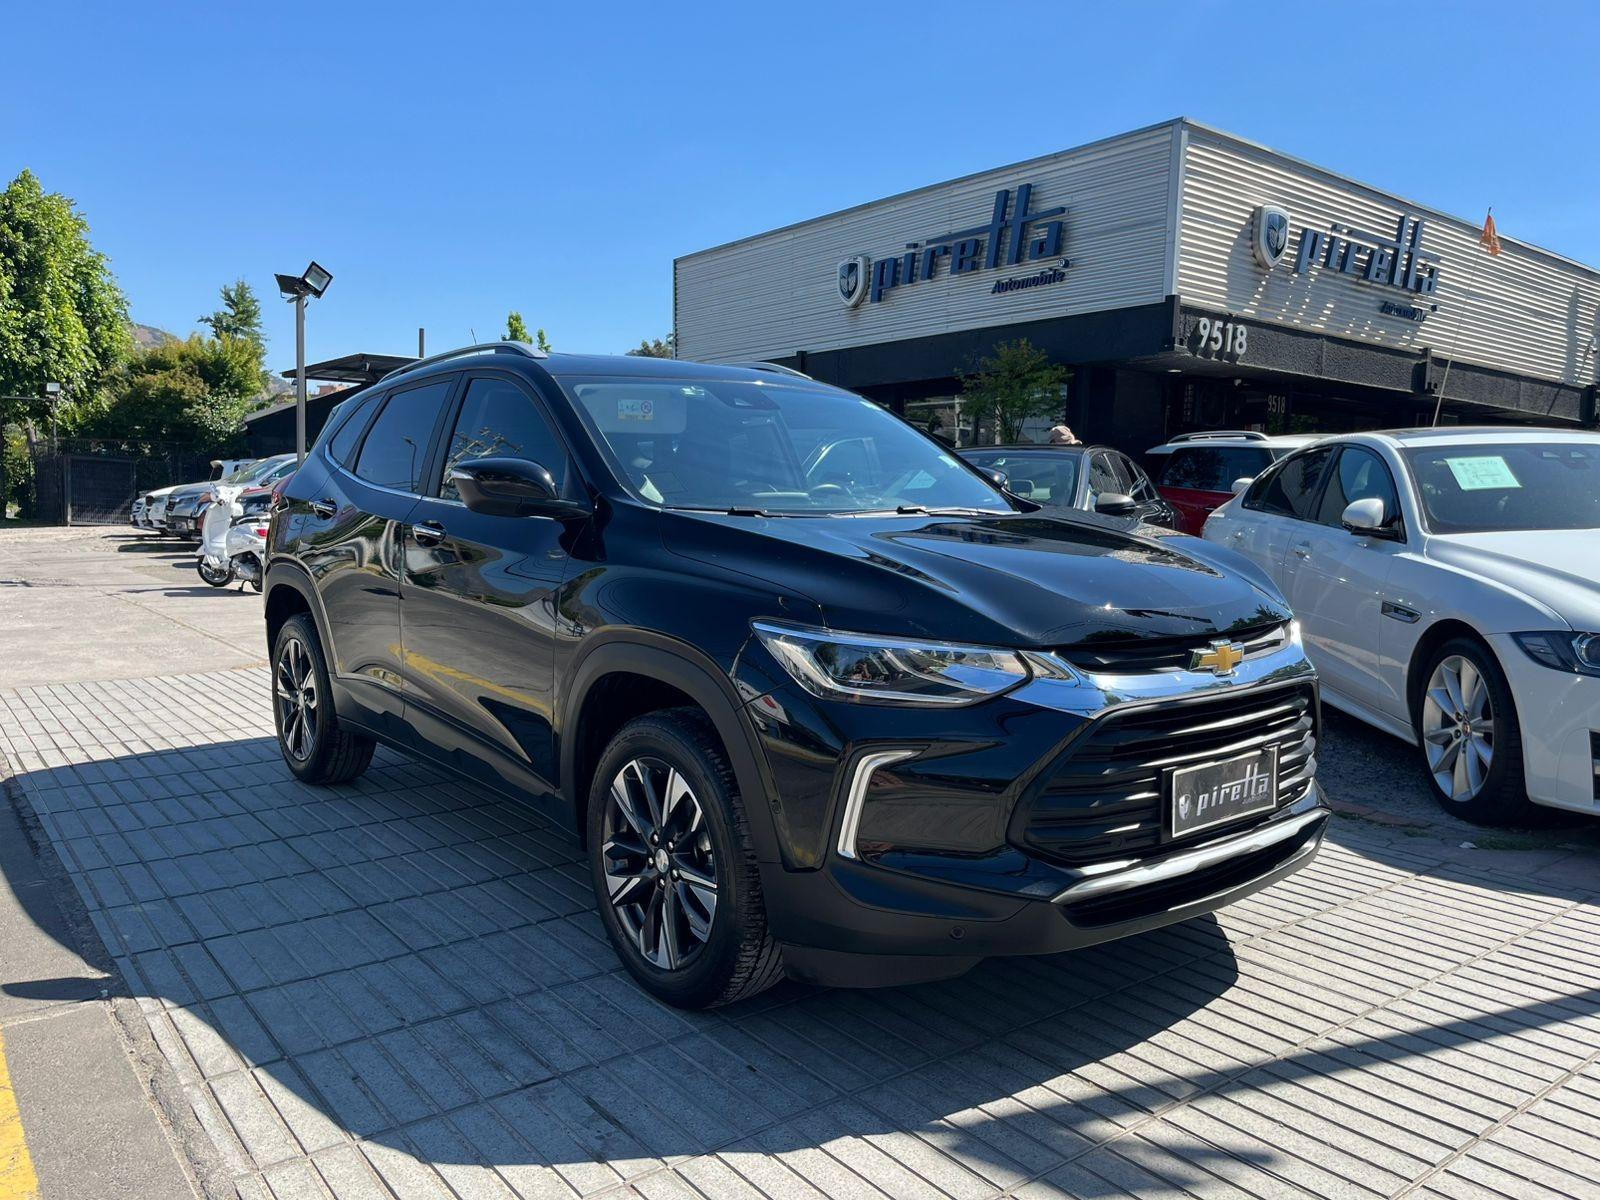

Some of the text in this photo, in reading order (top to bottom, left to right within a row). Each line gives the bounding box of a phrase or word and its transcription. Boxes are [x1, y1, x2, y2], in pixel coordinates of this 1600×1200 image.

[870, 183, 1066, 303] piretta
[1198, 317, 1248, 355] 9518
[1267, 395, 1286, 414] 9518
[1197, 763, 1270, 816] piretta
